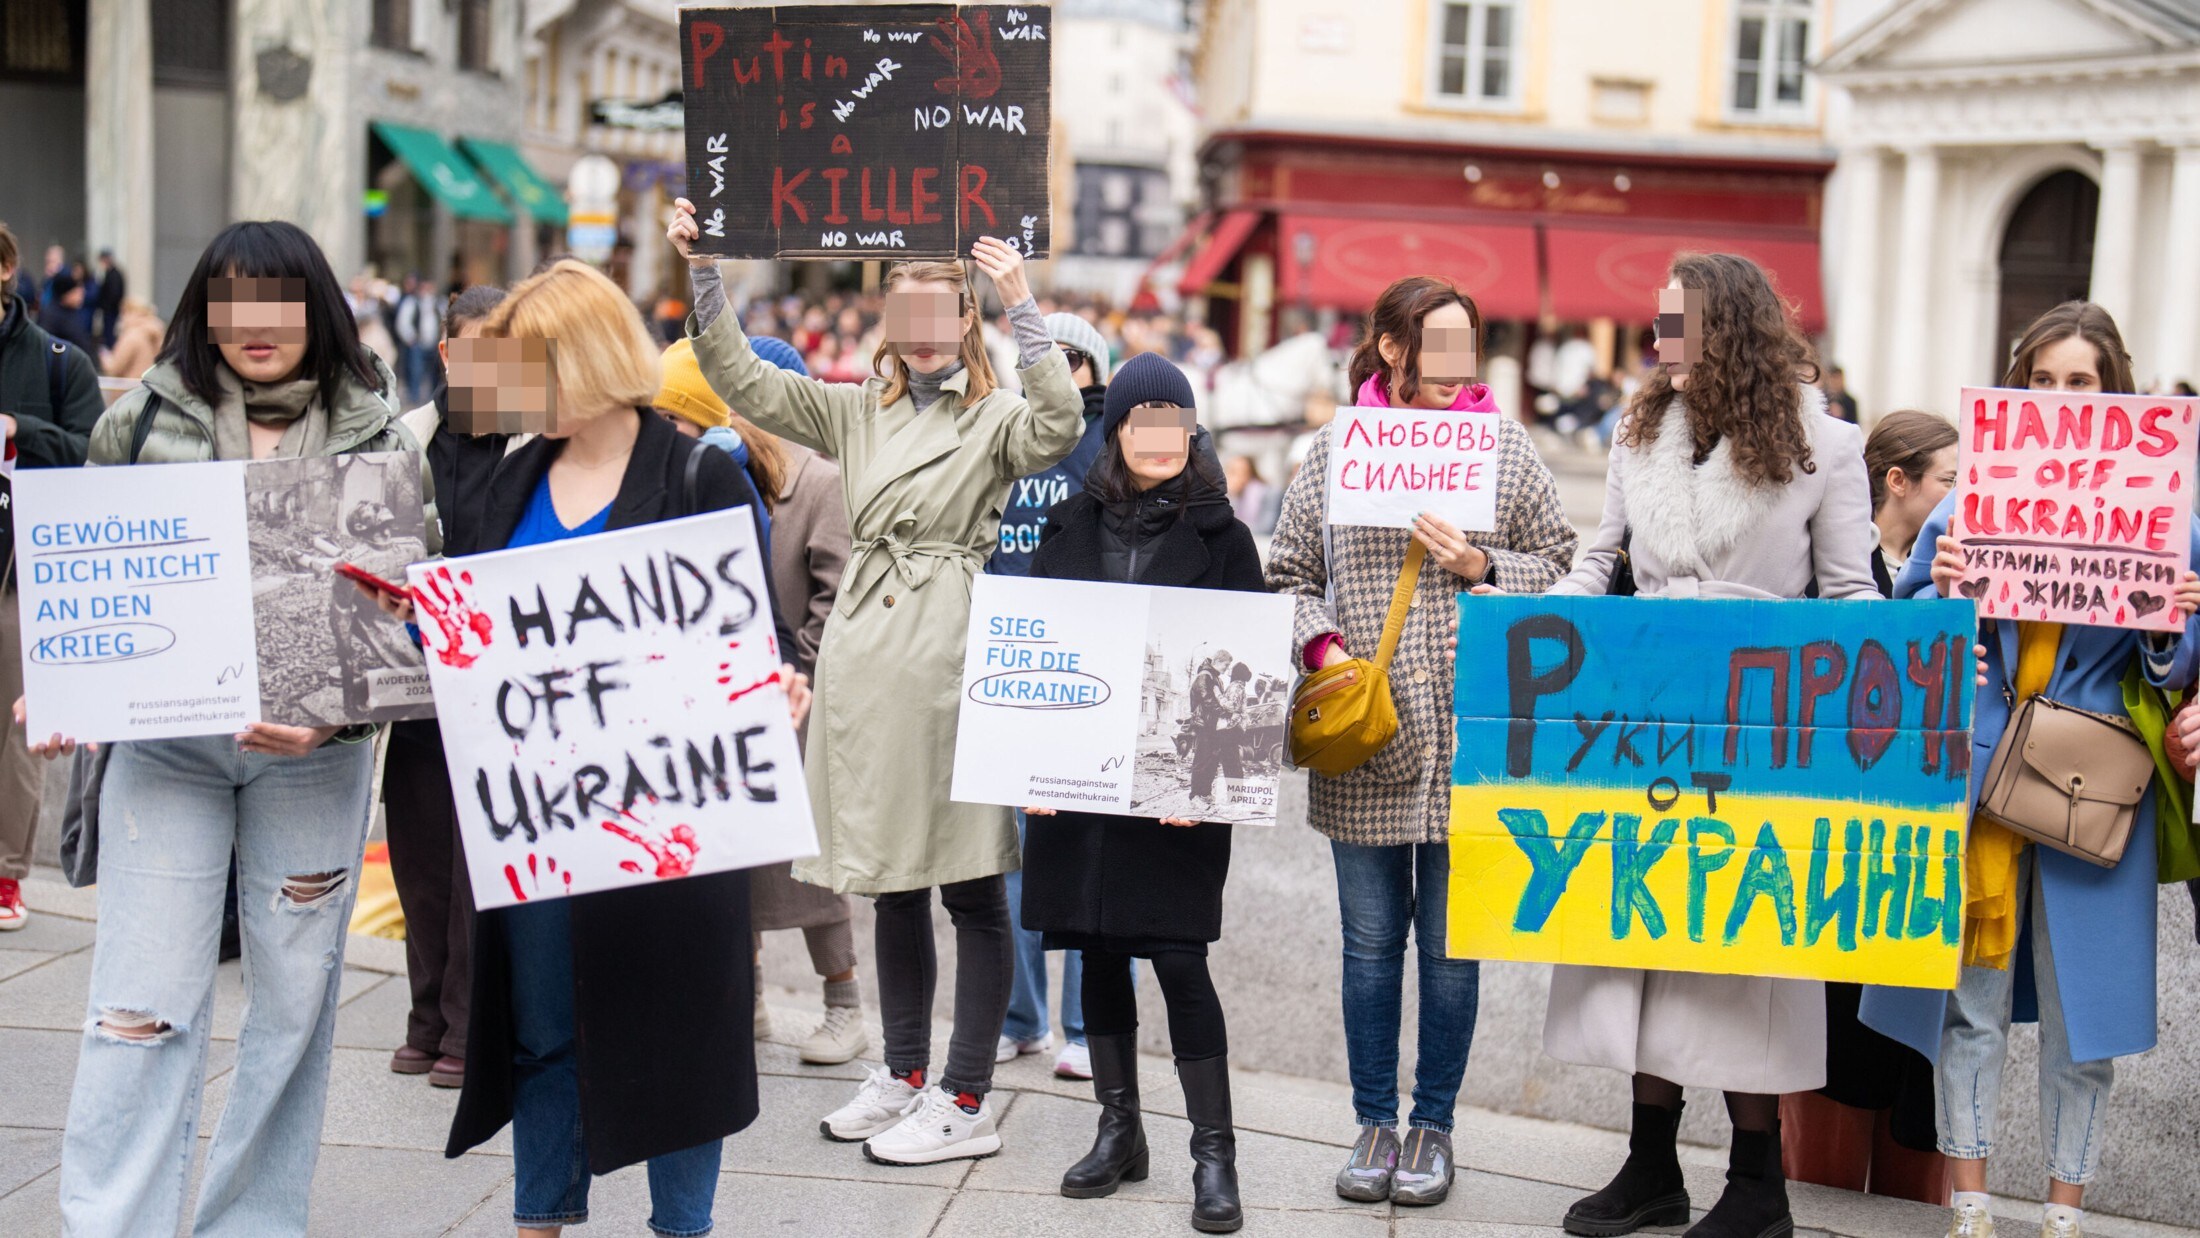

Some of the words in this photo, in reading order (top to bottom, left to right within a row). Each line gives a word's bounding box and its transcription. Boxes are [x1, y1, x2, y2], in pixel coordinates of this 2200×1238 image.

[998, 25, 1046, 41] WAR
[690, 21, 849, 88] Putin
[851, 57, 903, 99] WAR
[776, 94, 817, 131] is
[914, 105, 951, 132] NO
[963, 104, 1027, 135] WAR
[831, 133, 853, 154] a
[706, 132, 729, 198] WAR
[771, 164, 998, 232] KILLER
[821, 231, 848, 248] NO
[855, 230, 906, 248] WAR
[1343, 418, 1496, 451] ЛЮБОВЬ
[1972, 398, 2180, 457] HANDS
[1340, 459, 1484, 492] СИЛЬНЕЕ
[2034, 458, 2117, 491] OFF
[1015, 474, 1069, 508] ХУЙ
[31, 516, 190, 547] GEWÖHNE
[34, 557, 113, 585] DICH
[124, 553, 221, 579] NICHT
[1962, 548, 2062, 574] УКРАИНА
[2070, 556, 2176, 586] НАВЕКИ
[36, 599, 80, 622] AN
[91, 594, 152, 619] DEN
[509, 546, 757, 649] HANDS
[2022, 579, 2110, 613] ЖИВА
[988, 616, 1046, 639] SIEG
[38, 632, 136, 660] KRIEG
[986, 643, 1033, 669] FÜR
[1040, 651, 1081, 673] DIE
[128, 695, 242, 709] #russiansagainstwar
[406, 686, 433, 696] 2024
[496, 657, 631, 742] OFF
[982, 677, 1098, 706] UKRAINE!
[129, 710, 247, 726] #westandwithukraine
[1028, 788, 1120, 803] #westandwithukraine
[1029, 775, 1119, 789] #russiansagainstwar
[1226, 784, 1275, 796] MARIUPOL
[1230, 795, 1258, 805] APRIL
[1497, 807, 1961, 952] УКРАИНЫ
